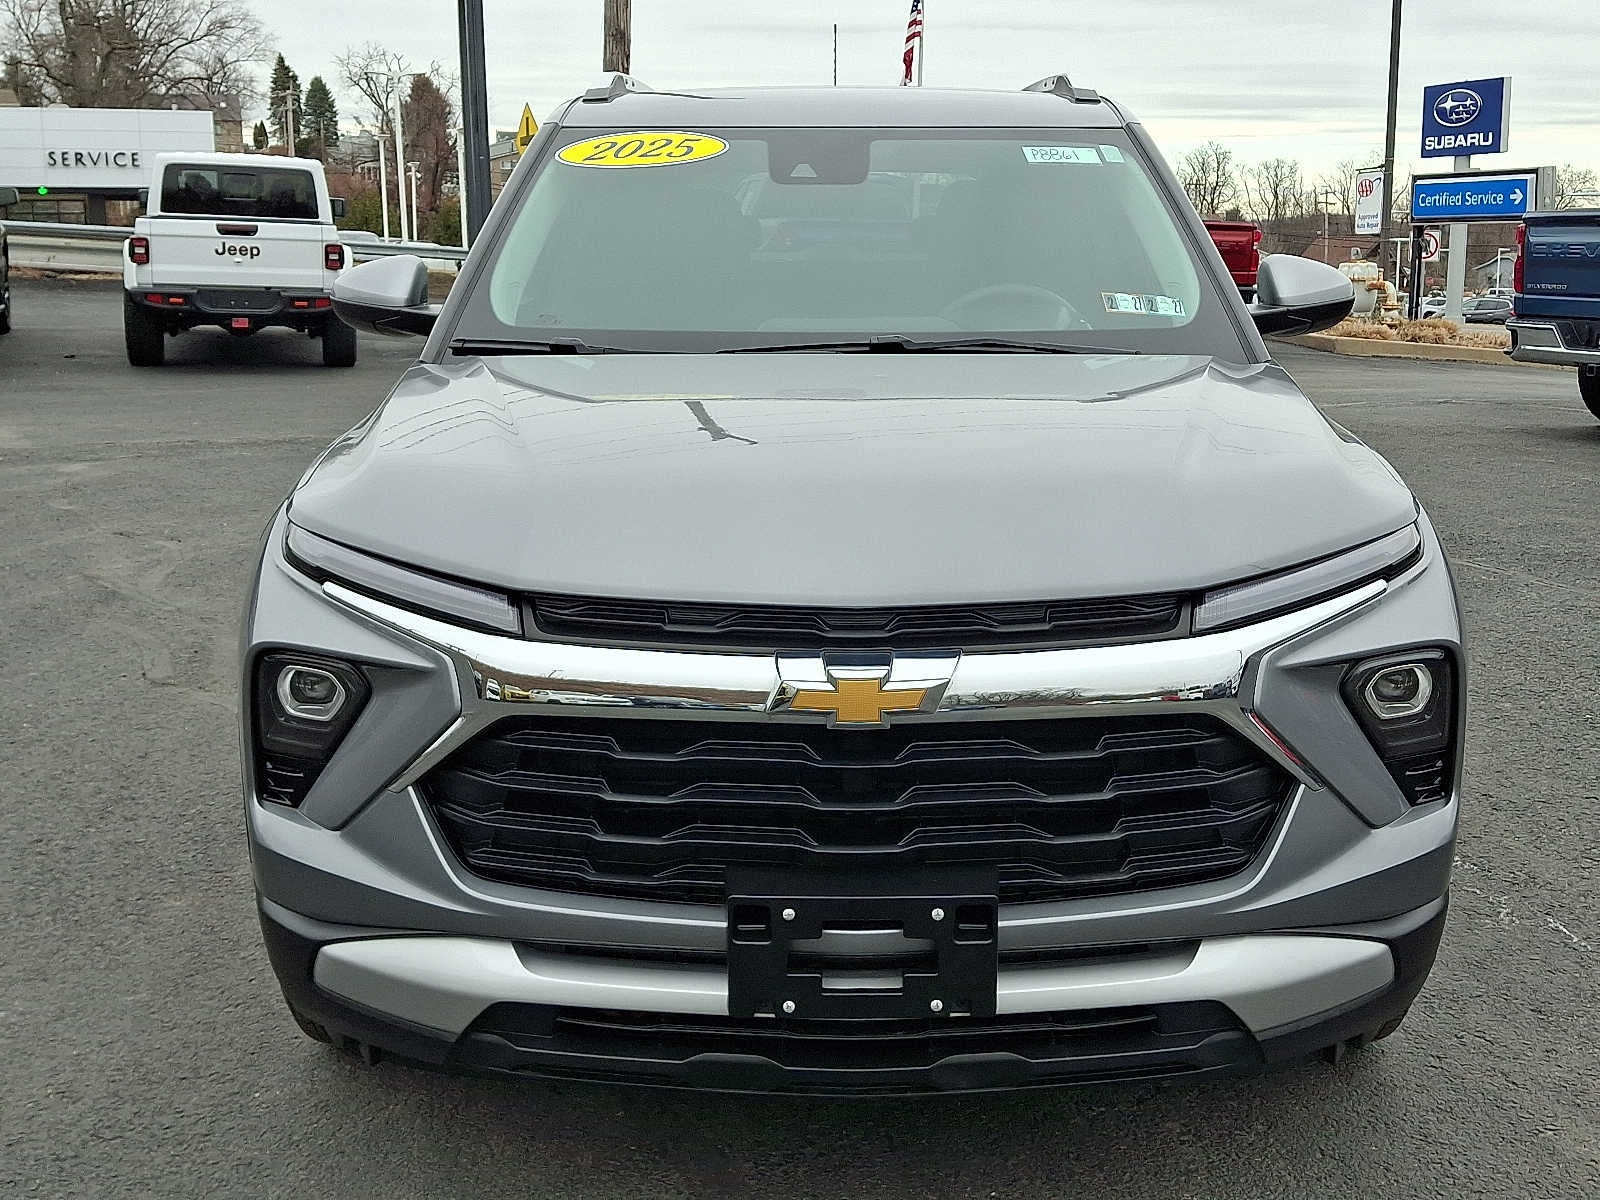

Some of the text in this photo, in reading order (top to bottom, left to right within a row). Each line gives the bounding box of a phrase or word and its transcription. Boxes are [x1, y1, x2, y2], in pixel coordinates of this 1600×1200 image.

[1424, 131, 1493, 150] SUBARU
[582, 138, 702, 162] 2025
[47, 151, 140, 168] SERVICE
[1418, 190, 1504, 207] Certified Service
[214, 241, 261, 259] Jeep
